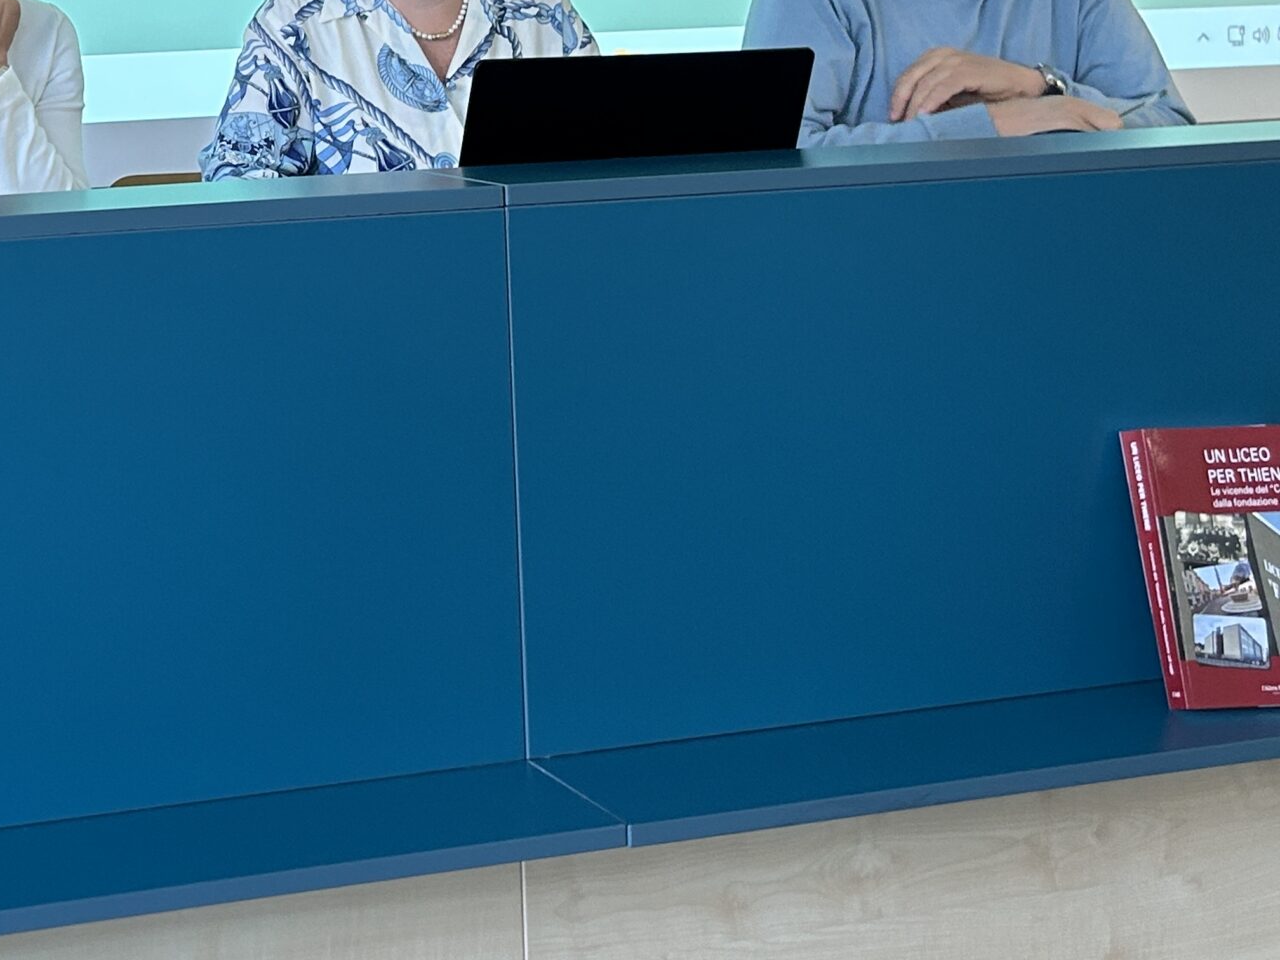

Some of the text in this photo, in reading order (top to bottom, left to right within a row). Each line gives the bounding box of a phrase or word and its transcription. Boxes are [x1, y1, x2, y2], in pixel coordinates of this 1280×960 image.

[1204, 446, 1271, 464] UN LICEO
[1207, 468, 1236, 484] PER
[1210, 486, 1221, 496] Le
[1221, 485, 1254, 496] vicende
[1255, 484, 1269, 494] del
[1212, 497, 1279, 509] dalla fondazione
